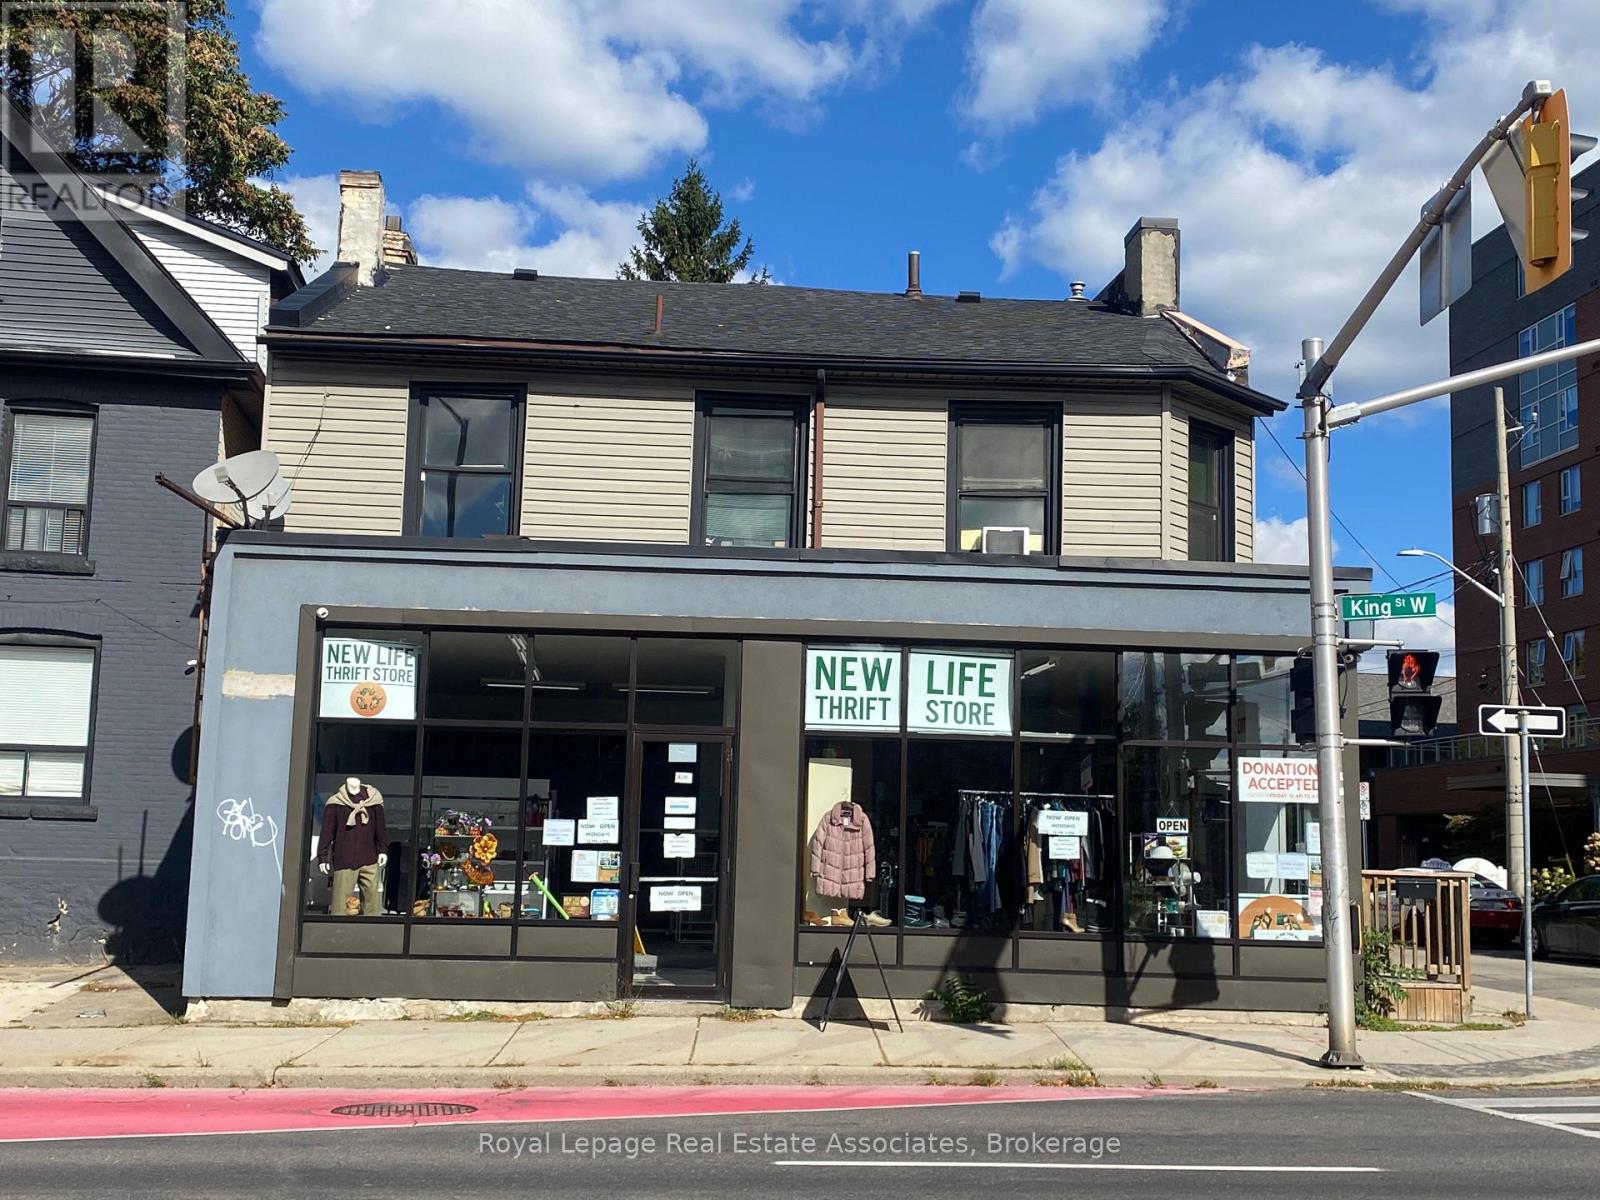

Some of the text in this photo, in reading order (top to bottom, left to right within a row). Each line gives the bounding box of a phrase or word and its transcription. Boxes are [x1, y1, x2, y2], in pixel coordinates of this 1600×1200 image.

[1351, 597, 1427, 618] King St W
[327, 643, 414, 667] NEW LIFE
[326, 666, 413, 683] THRIFT STORE
[815, 656, 997, 697] NEW LIFE
[815, 695, 995, 726] THRIFT STORE
[1242, 762, 1320, 776] DONATION
[1158, 820, 1187, 832] OPEN
